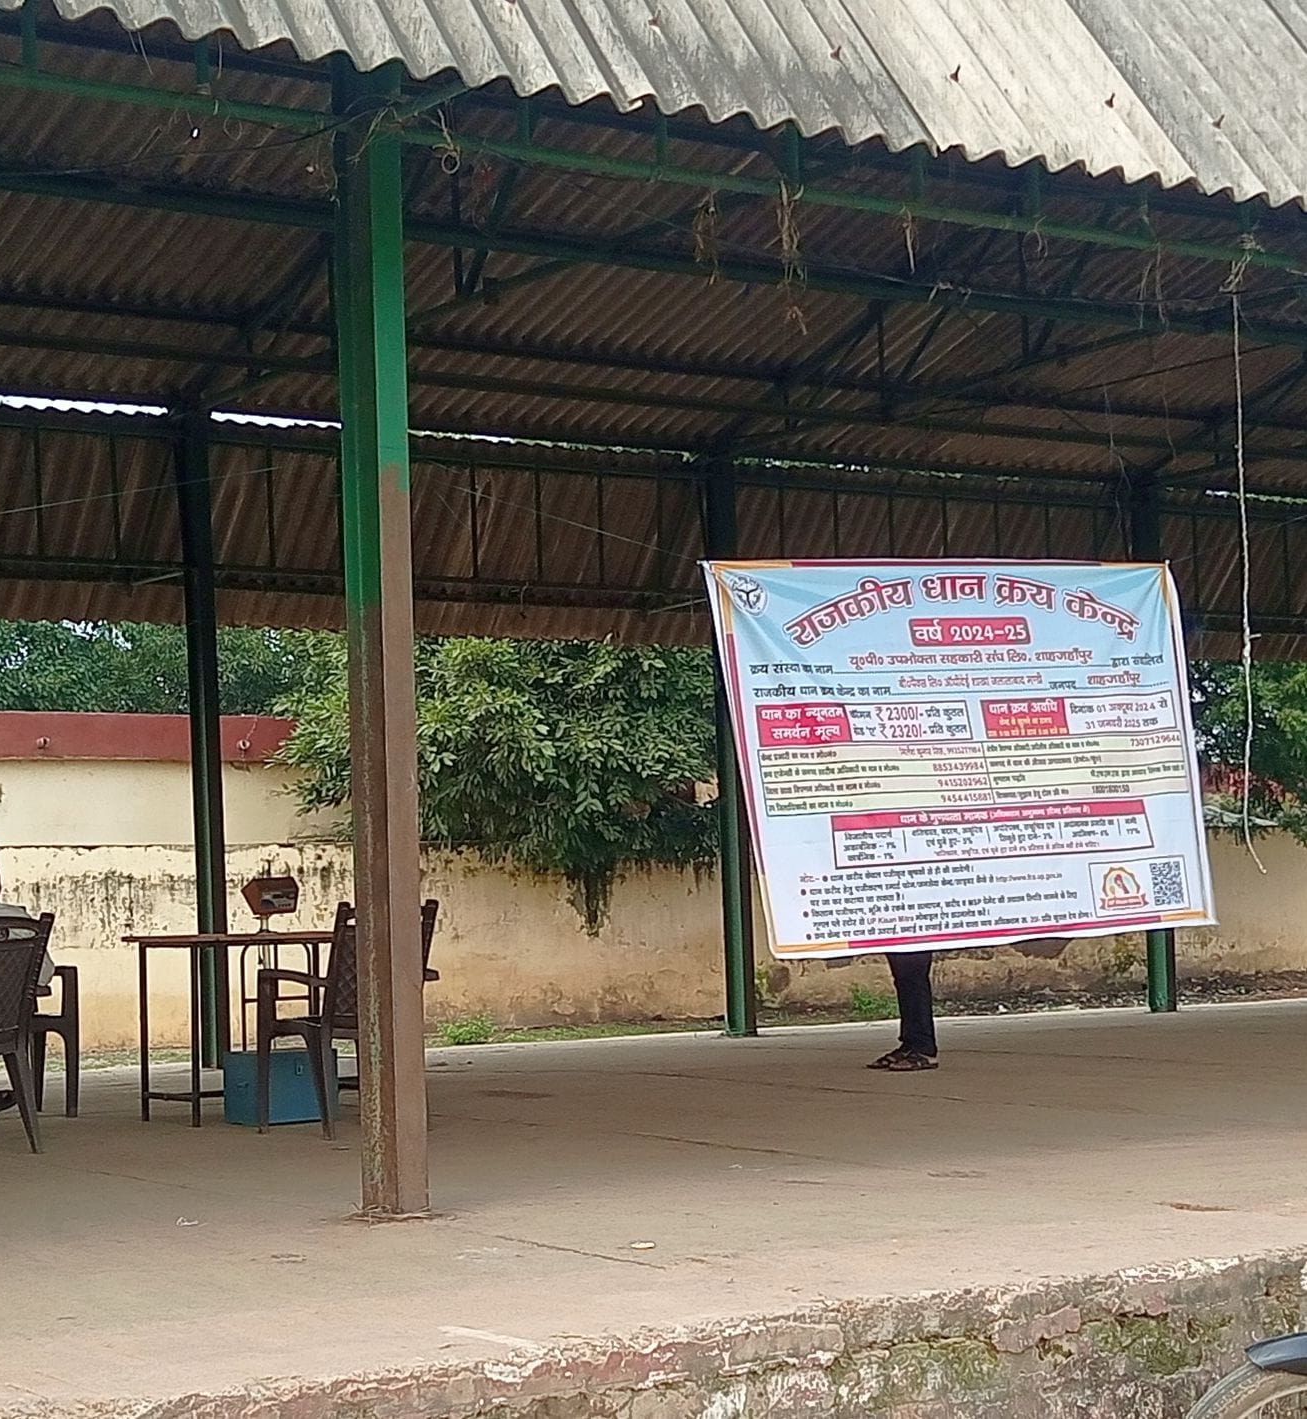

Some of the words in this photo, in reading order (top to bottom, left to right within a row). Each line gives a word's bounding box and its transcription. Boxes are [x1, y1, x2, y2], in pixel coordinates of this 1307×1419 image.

[784, 577, 914, 646] राजकीय
[921, 572, 987, 603] धान
[995, 574, 1056, 610] क्रय
[1063, 588, 1141, 642] केन्द्र
[913, 621, 942, 642] वर्ष
[887, 651, 937, 665] उपभोक्ता
[941, 650, 982, 665] सहकारी
[753, 684, 796, 698] राजकीय
[761, 707, 782, 720] धान
[784, 707, 801, 719] का
